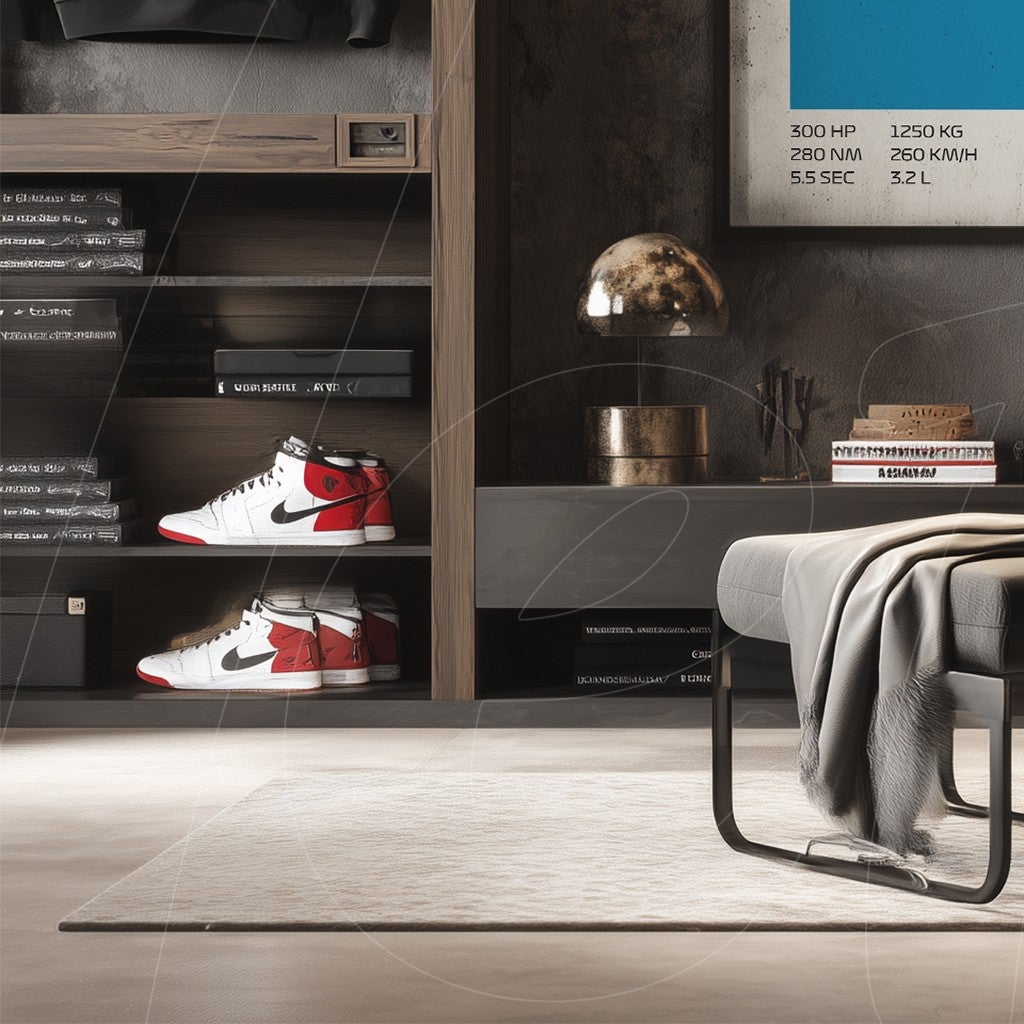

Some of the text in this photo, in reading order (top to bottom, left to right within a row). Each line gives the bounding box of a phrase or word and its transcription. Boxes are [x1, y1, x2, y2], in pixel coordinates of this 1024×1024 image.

[790, 124, 857, 139] 300 HP
[890, 124, 964, 139] 1250 KG
[790, 147, 863, 162] 280 NM
[890, 147, 978, 163] 260 KM/H
[790, 170, 855, 185] 5.5 SEC
[890, 170, 931, 185] 3.2 L
